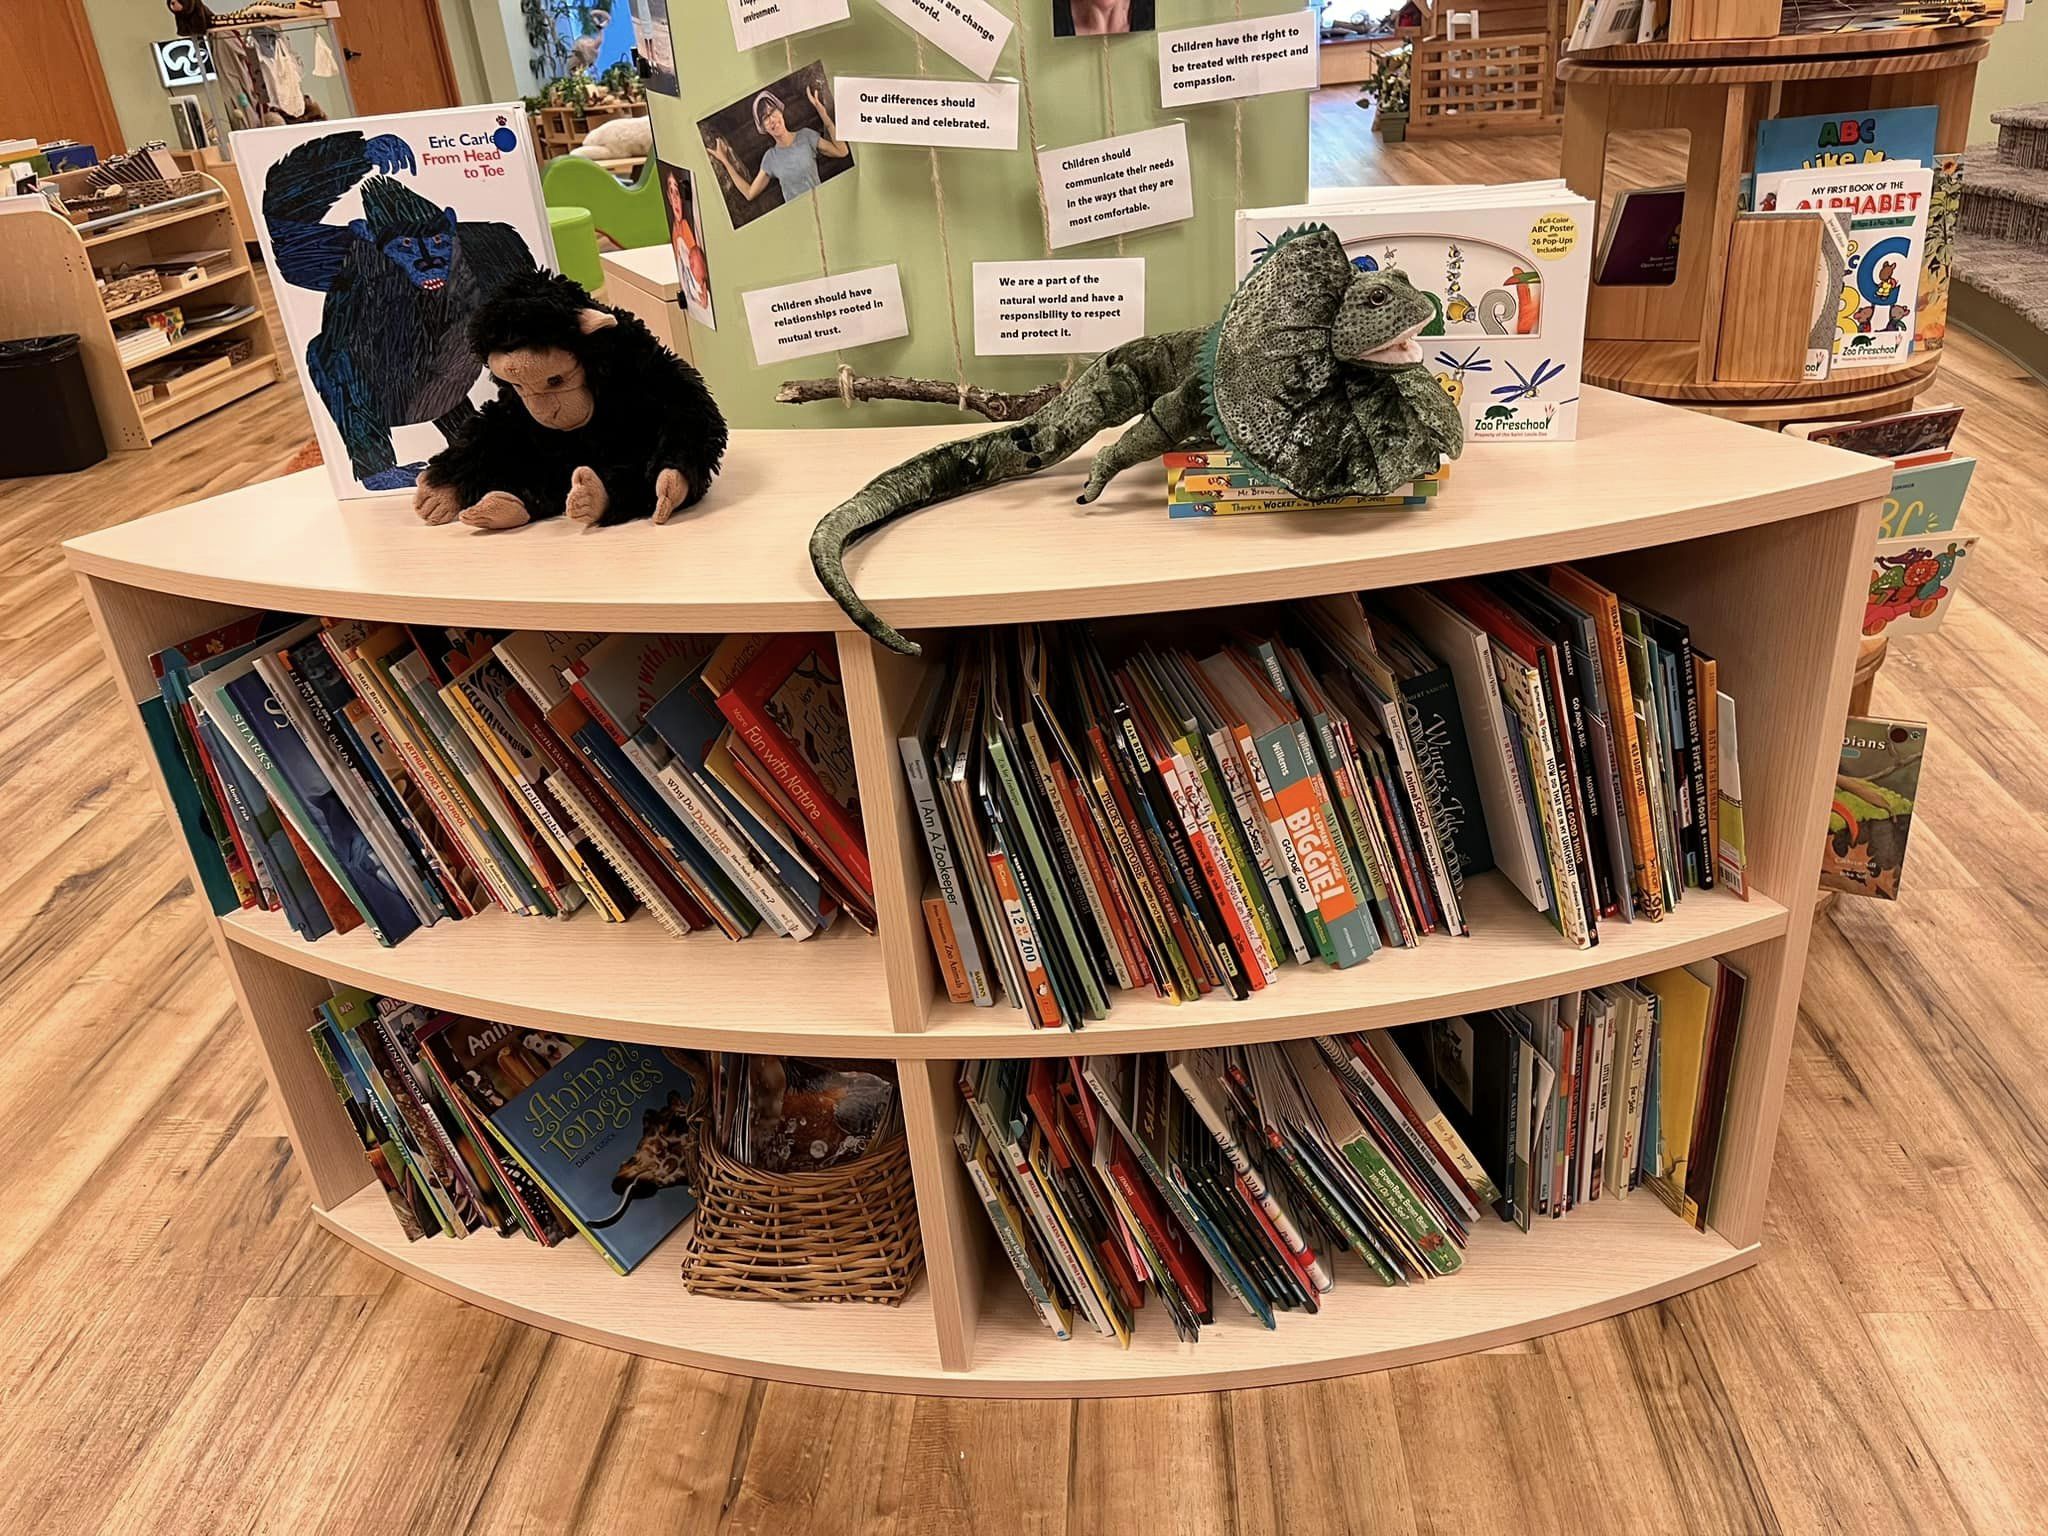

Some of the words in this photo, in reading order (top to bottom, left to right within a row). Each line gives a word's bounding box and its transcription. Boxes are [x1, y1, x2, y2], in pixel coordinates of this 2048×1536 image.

[911, 0, 940, 22] world.
[944, 0, 962, 16] are
[961, 11, 997, 43] change
[1171, 39, 1213, 52] Children
[1215, 35, 1239, 46] have
[1242, 32, 1258, 42] the
[1260, 28, 1285, 42] right
[1288, 27, 1299, 36] to
[1172, 63, 1184, 72] be
[1187, 57, 1223, 70] treated
[1225, 54, 1248, 64] with
[1251, 49, 1287, 63] respect
[1289, 45, 1308, 56] and
[1172, 72, 1235, 90] compassion.
[860, 93, 878, 102] Our
[881, 93, 937, 105] differences
[941, 97, 975, 107] should
[860, 113, 872, 122] be
[875, 114, 908, 124] valued
[911, 116, 929, 125] and
[933, 116, 989, 129] celebrated.
[1818, 118, 1876, 148] ABC
[429, 136, 456, 148] Eric
[422, 153, 460, 165] From
[464, 148, 501, 162] Head
[1061, 155, 1099, 170] Children
[1100, 147, 1131, 162] should
[464, 168, 478, 178] to
[479, 165, 504, 177] Toe
[1064, 169, 1124, 189] communicate
[1125, 164, 1147, 175] their
[1148, 157, 1174, 170] needs
[1066, 198, 1076, 208] in
[1077, 194, 1092, 205] the
[1094, 190, 1117, 203] ways
[1118, 184, 1136, 196] that
[1138, 181, 1158, 194] they
[1159, 178, 1174, 187] are
[1812, 187, 1825, 195] MY
[1827, 185, 1847, 194] FIRST
[1849, 184, 1874, 192] BOOK
[1876, 182, 1888, 190] OF
[1890, 181, 1904, 189] THE
[1068, 215, 1091, 226] most
[1093, 200, 1150, 221] comfortable.
[1796, 192, 1921, 215] ALPHABET
[999, 277, 1015, 286] We
[1046, 276, 1067, 286] part
[1069, 275, 1080, 283] of
[1083, 274, 1099, 283] the
[770, 297, 811, 312] Children
[813, 290, 846, 304] should
[848, 286, 872, 297] have
[999, 295, 1035, 304] natural
[1038, 294, 1067, 303] world
[1070, 293, 1088, 302] and
[1091, 293, 1114, 301] have
[773, 308, 837, 329] relationships
[838, 301, 871, 314] rooted
[873, 299, 883, 308] in
[1000, 310, 1068, 321] responsibility
[1084, 309, 1120, 319] respect
[777, 330, 812, 344] mutual
[814, 325, 841, 337] trust.
[1000, 330, 1018, 338] and
[1021, 328, 1057, 339] protect
[1060, 328, 1071, 336] it.
[1475, 419, 1493, 430] Zoo
[1496, 418, 1549, 430] Preschool
[1561, 640, 1575, 676] EMBERLEY
[1265, 655, 1287, 693] Willems
[356, 671, 372, 691] Marc
[369, 690, 388, 714] Brown
[1570, 697, 1580, 710] GO
[1572, 711, 1584, 733] AWAY,
[1685, 698, 1699, 743] Kitten's
[230, 711, 274, 772] SHARKS
[1123, 722, 1137, 740] JAN
[1131, 741, 1150, 769] BRETT
[1296, 731, 1314, 766] Willems
[1321, 724, 1337, 759] Willems
[1426, 713, 1451, 792] Winter's
[1577, 733, 1587, 747] BIG
[730, 706, 750, 728] More
[743, 723, 770, 751] Fun
[761, 745, 792, 779] with
[782, 773, 825, 821] Nature
[1271, 741, 1291, 777] Willems
[1690, 745, 1702, 770] First
[402, 739, 427, 771] ARTHUR
[424, 769, 441, 790] GOES
[437, 789, 448, 801] TO
[444, 799, 466, 828] SCHOOL
[1558, 768, 1568, 782] AM
[1693, 773, 1704, 793] Full
[225, 781, 242, 806] About
[237, 805, 250, 823] Fish
[1402, 769, 1421, 801] Animal
[1412, 801, 1430, 829] School
[1560, 783, 1574, 810] EVERY
[1584, 775, 1599, 816] MONSTER!
[665, 777, 686, 800] Why
[682, 796, 696, 811] Do
[691, 808, 732, 855] Donkeys
[919, 804, 939, 828] Am
[1324, 813, 1336, 828] MY
[1349, 808, 1360, 825] WE
[1566, 811, 1578, 836] GOOD
[1695, 795, 1707, 826] Moon
[928, 829, 941, 842] A
[1100, 790, 1123, 831] TRICKY
[1116, 829, 1144, 879] TORTOISE
[1167, 829, 1178, 840] 3
[1330, 829, 1349, 863] FRIEND
[1355, 825, 1367, 843] ARE
[1170, 838, 1191, 868] Little
[1283, 806, 1345, 904] BIGGIE!
[1361, 843, 1370, 854] IN
[1364, 853, 1373, 861] A
[1571, 838, 1584, 863] THING
[931, 842, 961, 907] Zookeeper
[1182, 865, 1205, 900] Dassies
[1343, 865, 1352, 875] IS
[1367, 861, 1382, 888] BOOK!
[1346, 874, 1359, 894] SAD
[943, 943, 956, 959] Zoo
[1018, 936, 1037, 963] ZOO
[947, 958, 966, 989] Animals
[372, 1019, 409, 1074] EYEWITNESS
[404, 1072, 426, 1104] BOOKS
[525, 1043, 641, 1137] Animal
[1088, 1078, 1100, 1091] Eric
[1096, 1090, 1110, 1107] Carle
[1599, 1083, 1608, 1109] HUMANS
[363, 1085, 390, 1124] Animals
[541, 1058, 664, 1162] Tongues
